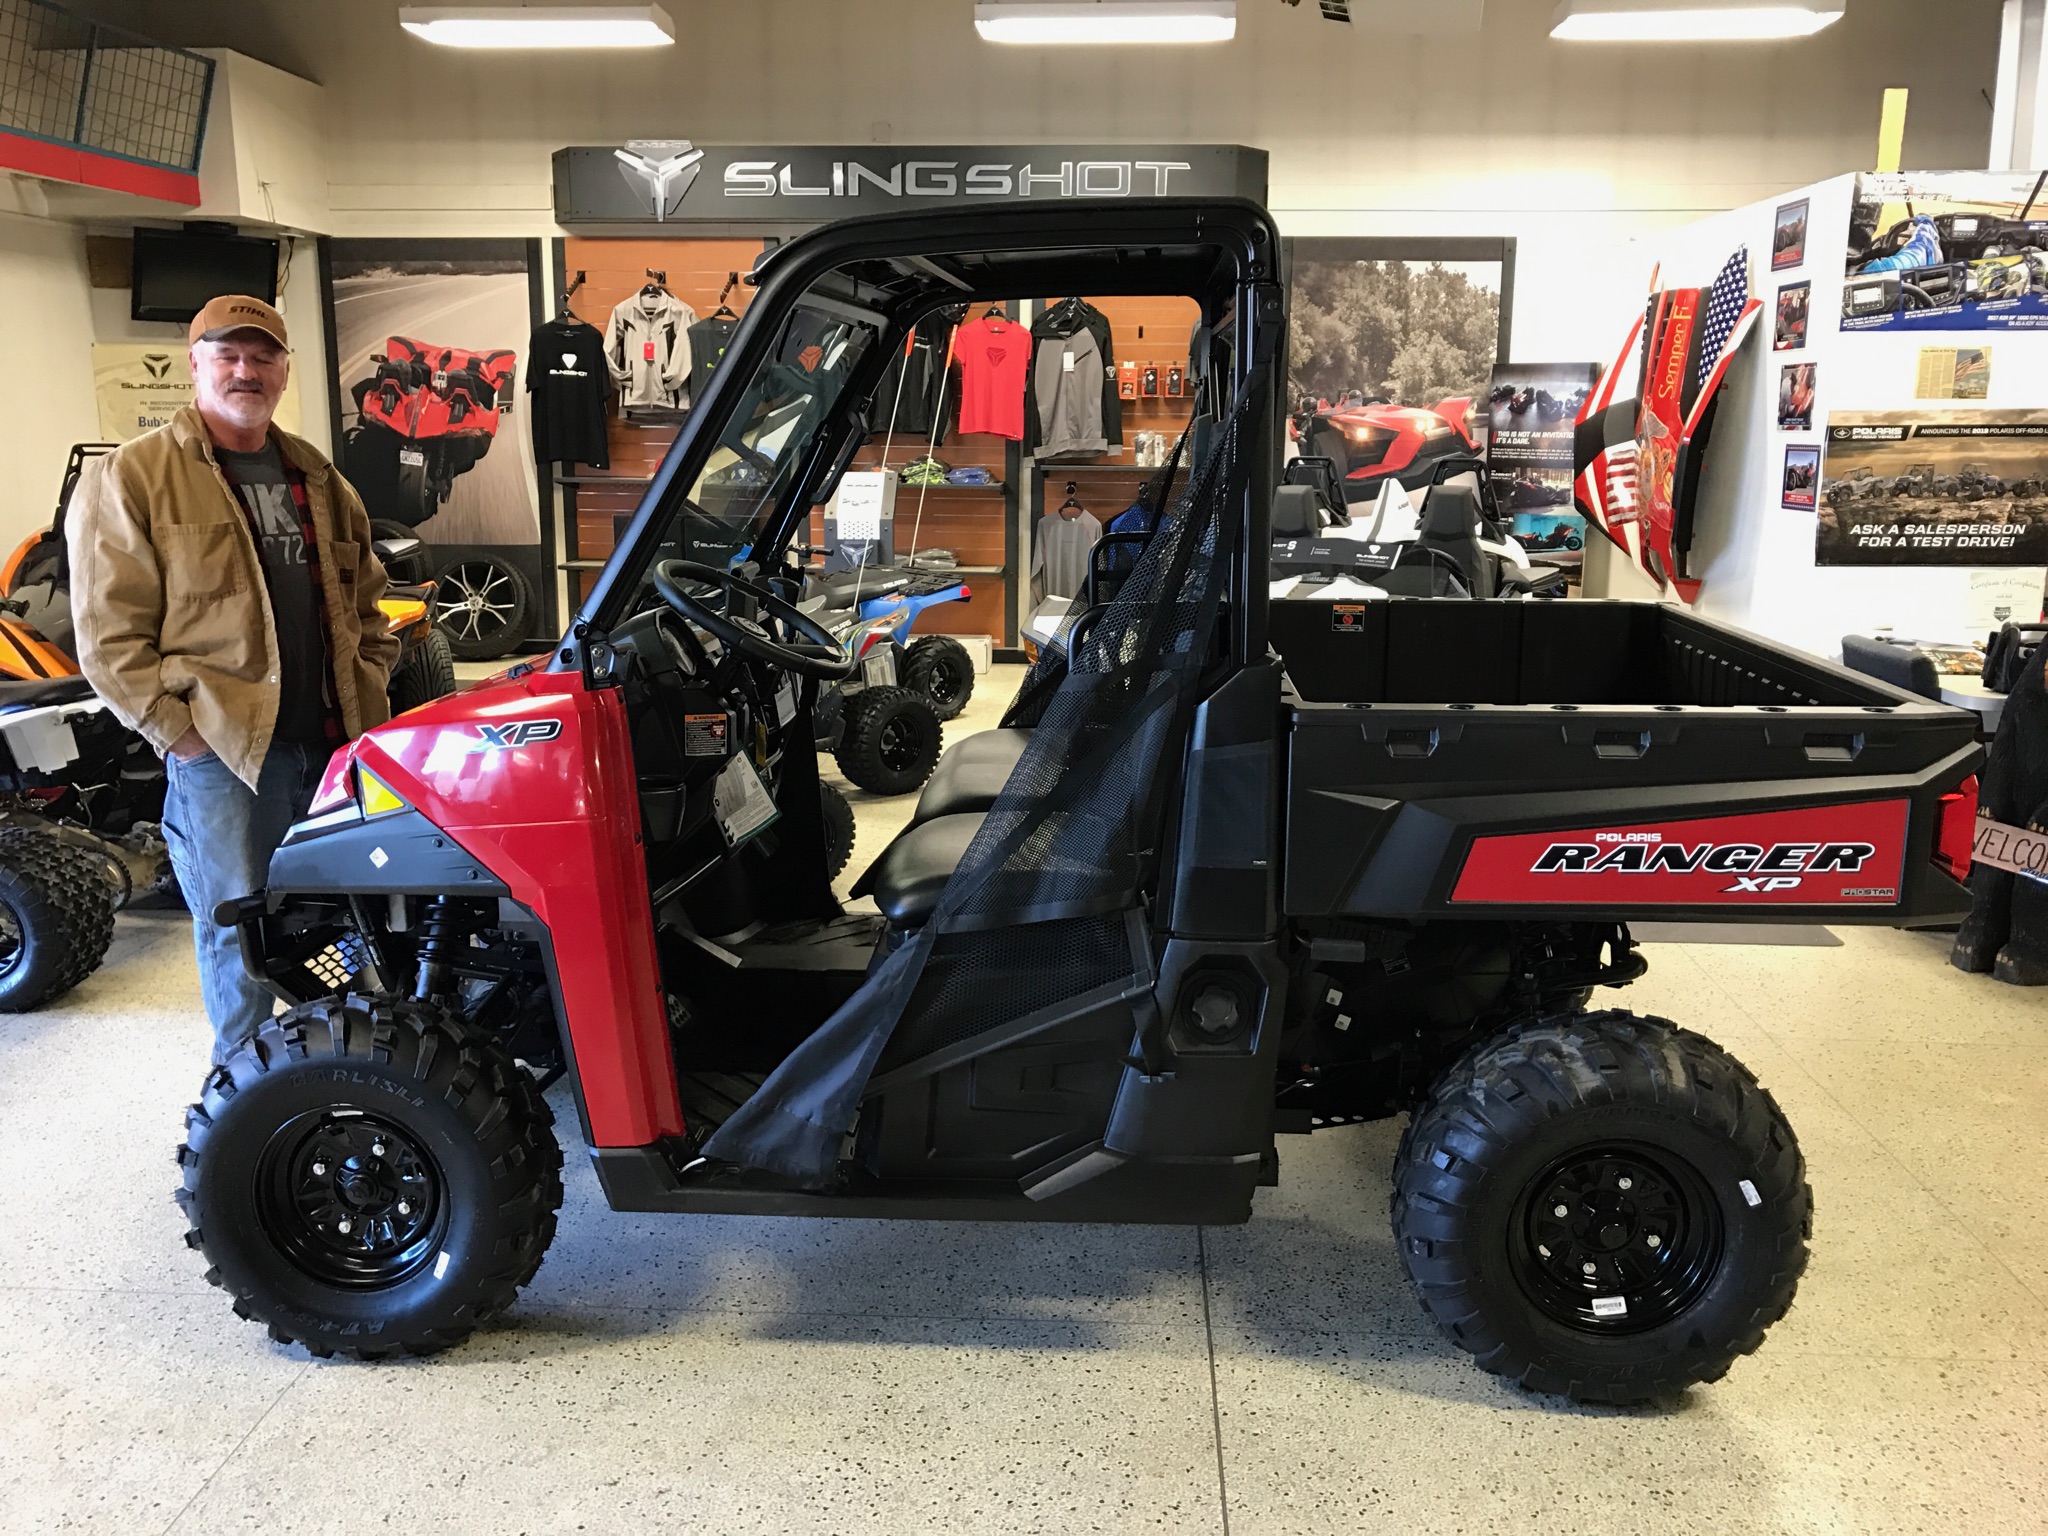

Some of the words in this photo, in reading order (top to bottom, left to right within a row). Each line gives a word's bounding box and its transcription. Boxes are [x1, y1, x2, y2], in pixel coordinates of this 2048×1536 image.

[724, 161, 1191, 196] SLINGSHOT
[228, 305, 269, 320] STIHL
[1658, 323, 1685, 398] Semper
[121, 382, 194, 390] SLINGSHOT
[138, 416, 170, 428] Bub's
[1542, 431, 1575, 439] INVITATIO
[1852, 427, 1903, 435] POLARIS
[1849, 525, 1885, 535] ASK
[1888, 525, 1901, 535] A
[1904, 524, 2026, 535] SALESPERSON
[1858, 537, 1892, 547] FOR
[1895, 537, 1907, 547] A
[1912, 536, 1954, 547] TEST
[1957, 536, 2015, 547] DRIVE!
[882, 578, 909, 590] POLARIS
[475, 718, 563, 749] XP
[1595, 832, 1662, 843] POLARIS
[1530, 842, 1876, 873] RANGER
[1718, 876, 1802, 893] XP
